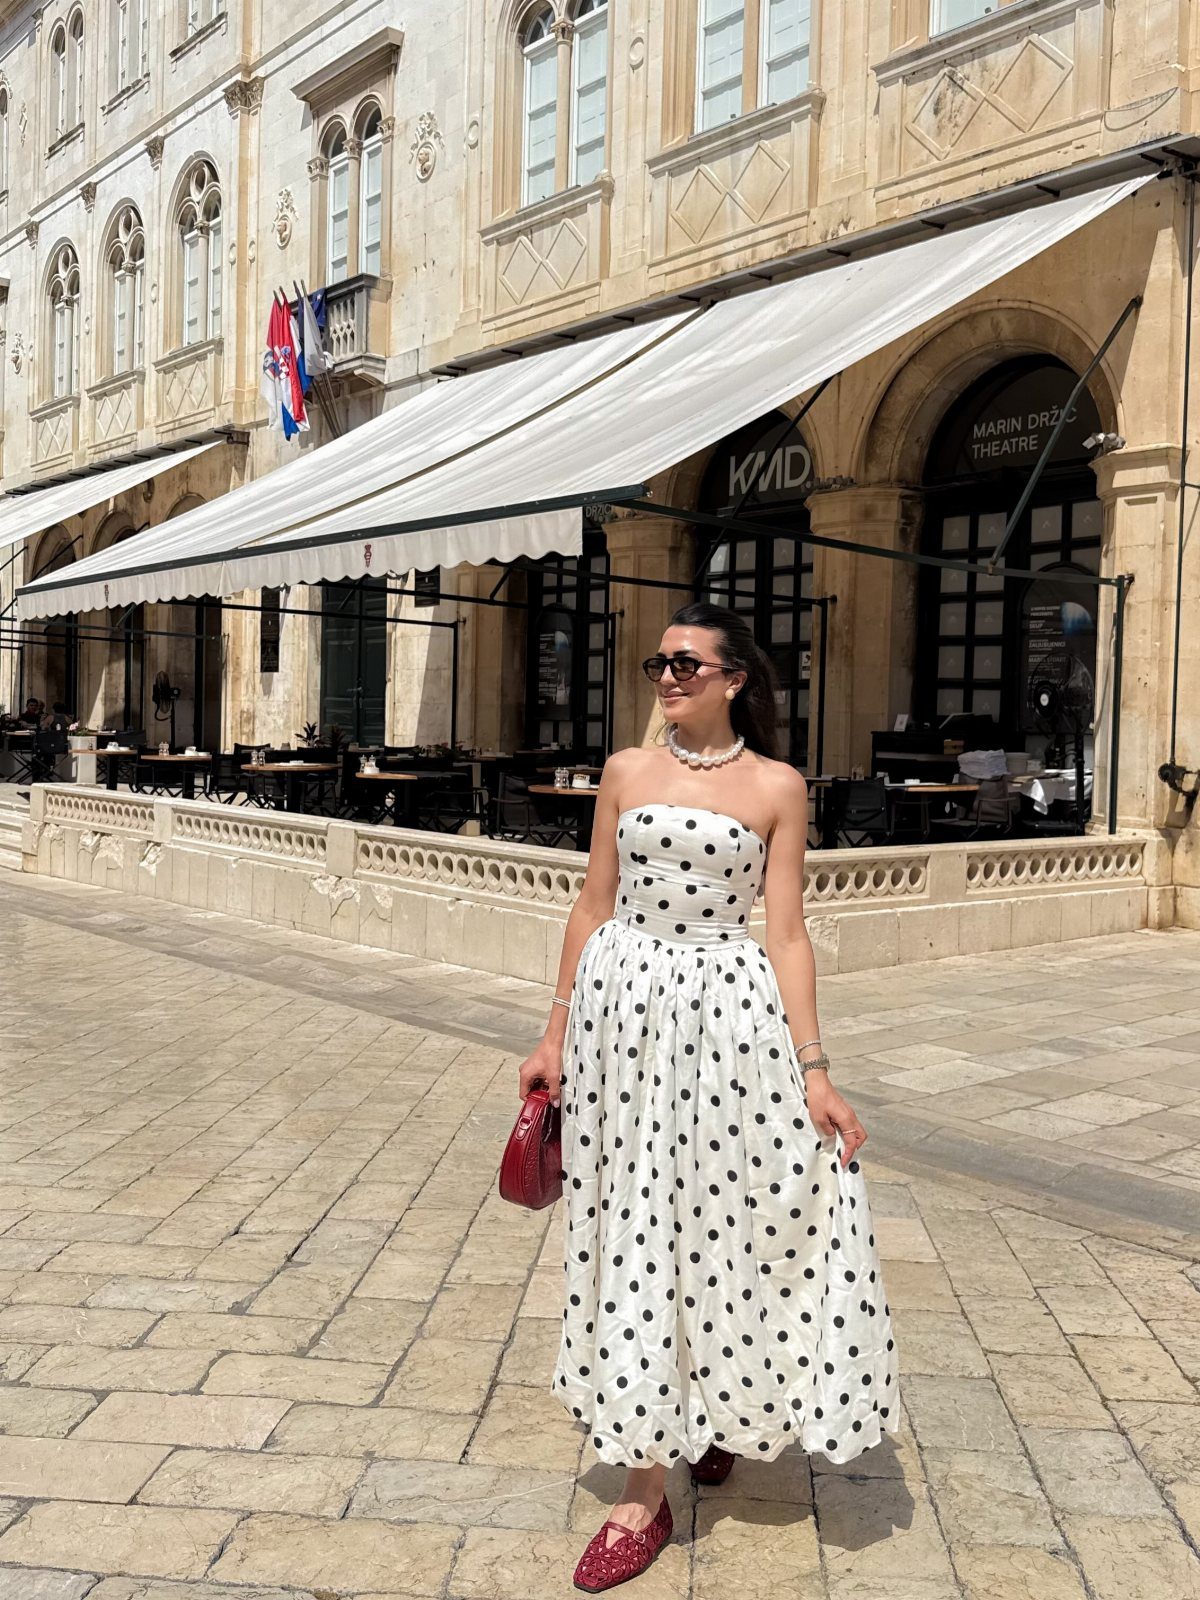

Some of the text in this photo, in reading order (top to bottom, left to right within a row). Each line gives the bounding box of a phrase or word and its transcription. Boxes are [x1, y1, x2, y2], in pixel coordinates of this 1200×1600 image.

[973, 416, 1022, 440] MARIN
[972, 434, 1039, 460] THEATRE
[728, 444, 812, 497] KMD
